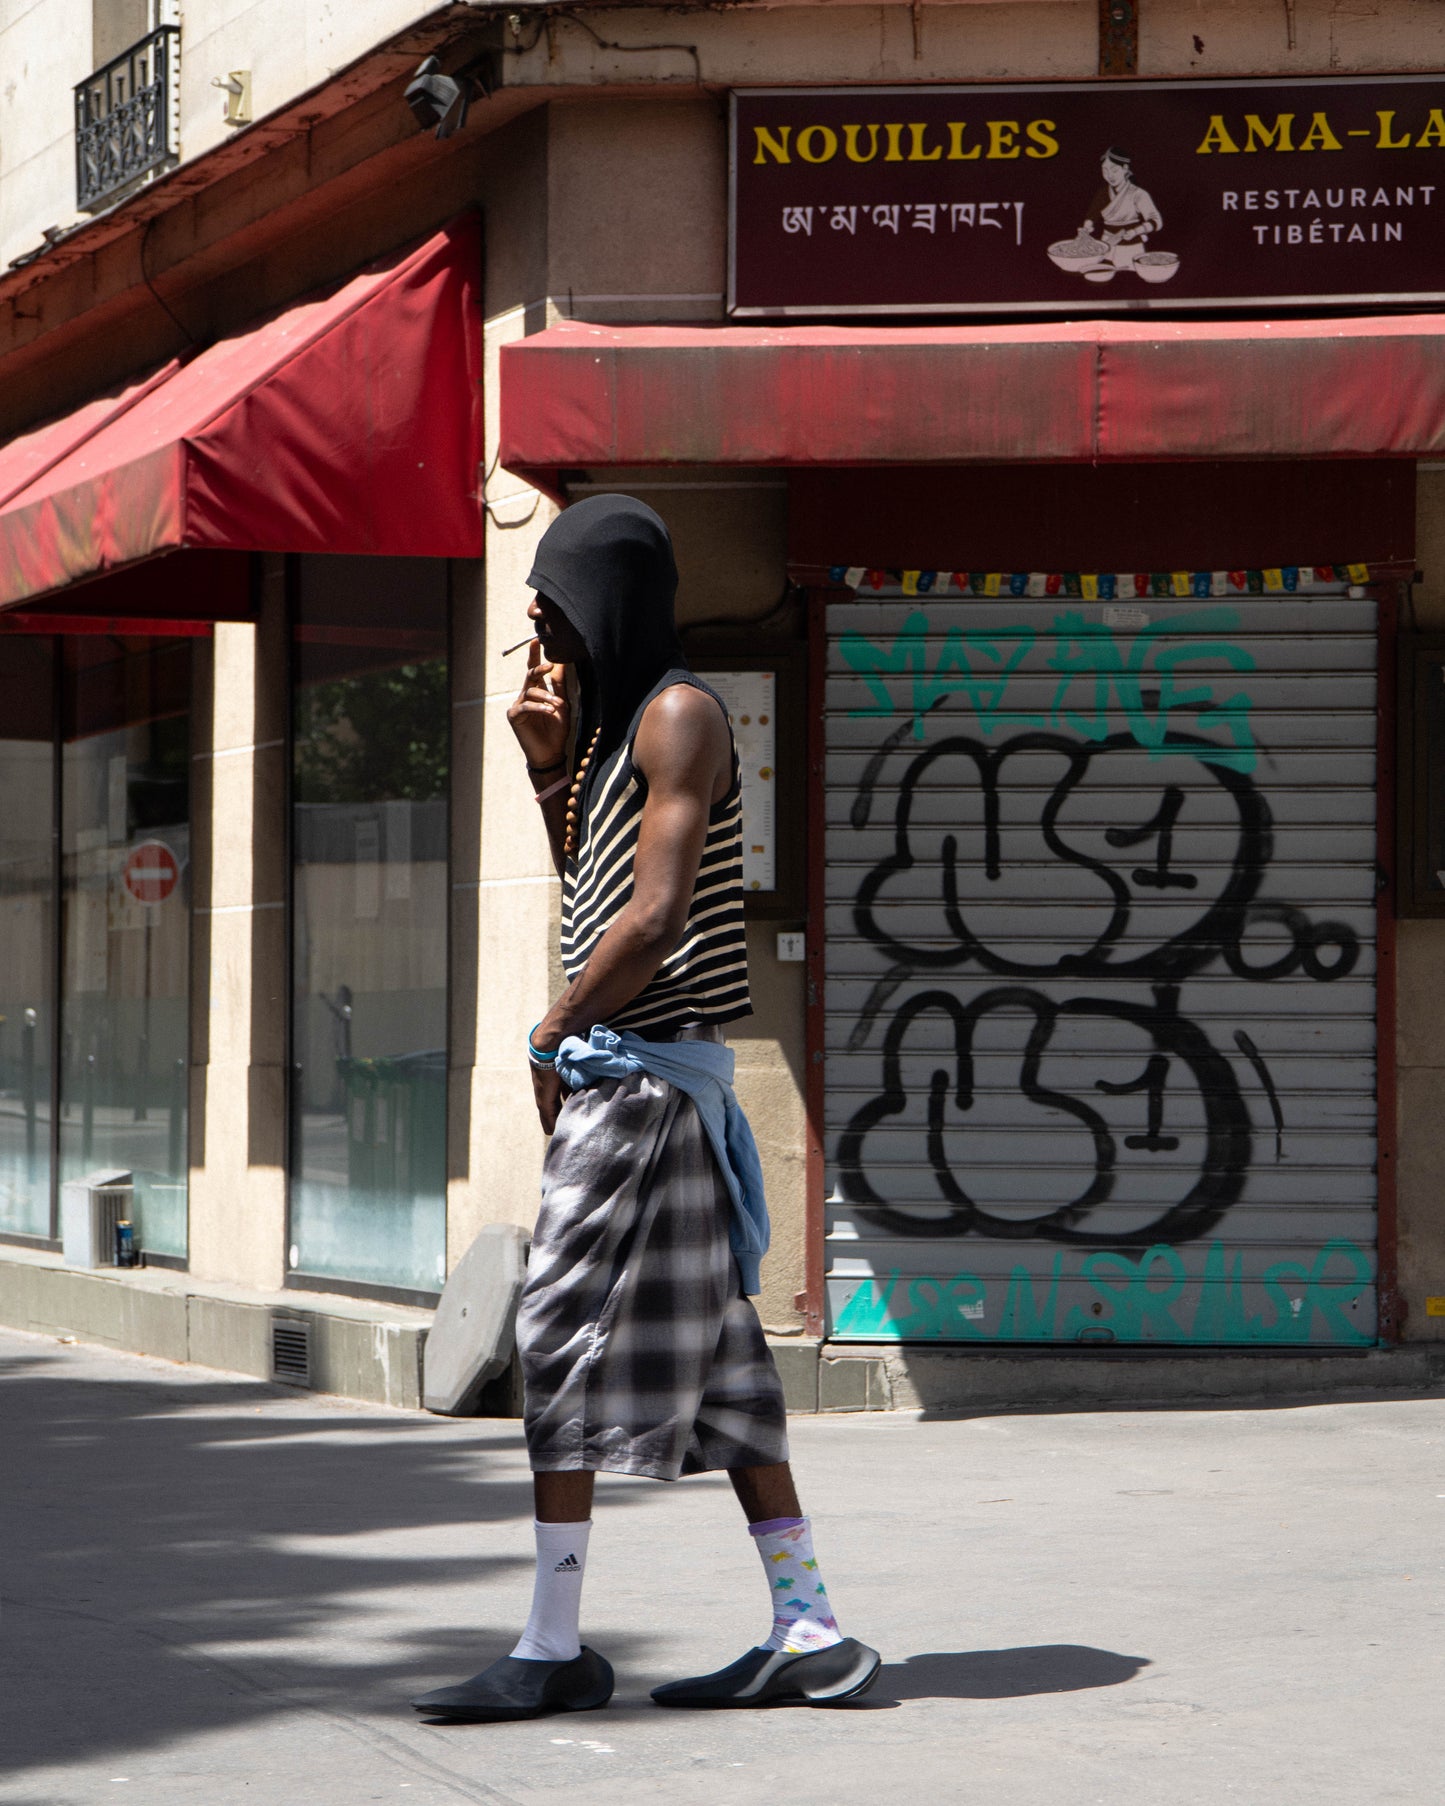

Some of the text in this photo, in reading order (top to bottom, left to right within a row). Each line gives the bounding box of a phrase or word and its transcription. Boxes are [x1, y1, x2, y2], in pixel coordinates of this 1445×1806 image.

[752, 119, 1060, 165] NOUILLES
[1196, 108, 1445, 154] AMA-LA
[1222, 186, 1436, 211] RESTAURANT
[1252, 217, 1403, 245] TIBÉTAIN
